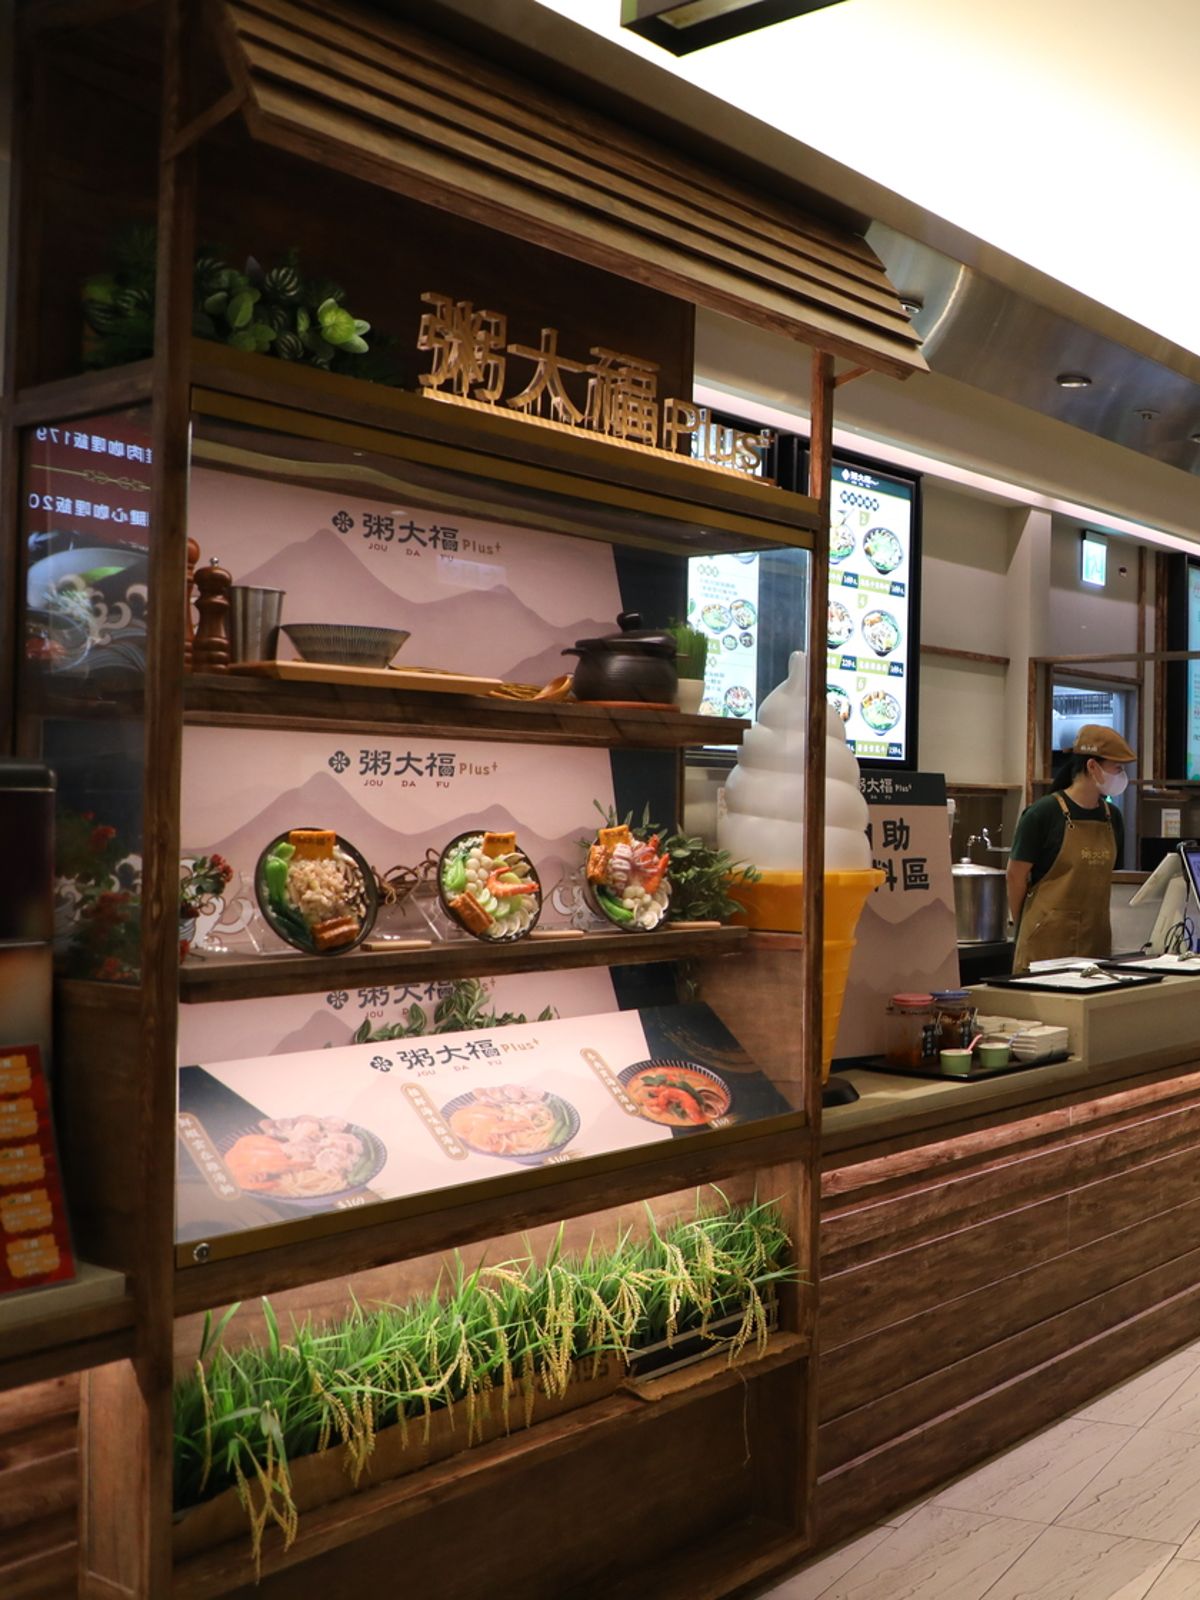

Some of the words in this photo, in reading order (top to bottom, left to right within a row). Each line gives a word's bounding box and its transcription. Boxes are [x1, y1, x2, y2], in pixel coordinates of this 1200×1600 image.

[417, 291, 660, 447] 粥大福
[362, 513, 459, 552] 粥大福
[368, 543, 388, 552] JOU
[406, 548, 421, 557] DA
[359, 750, 456, 777] 粥大福
[363, 780, 384, 788] JOU
[401, 780, 416, 788] DA
[436, 781, 450, 789] FU
[365, 1010, 384, 1019] JOU
[397, 1039, 501, 1070] 粥大福
[417, 1069, 436, 1077] JOU
[453, 1065, 469, 1073] DA
